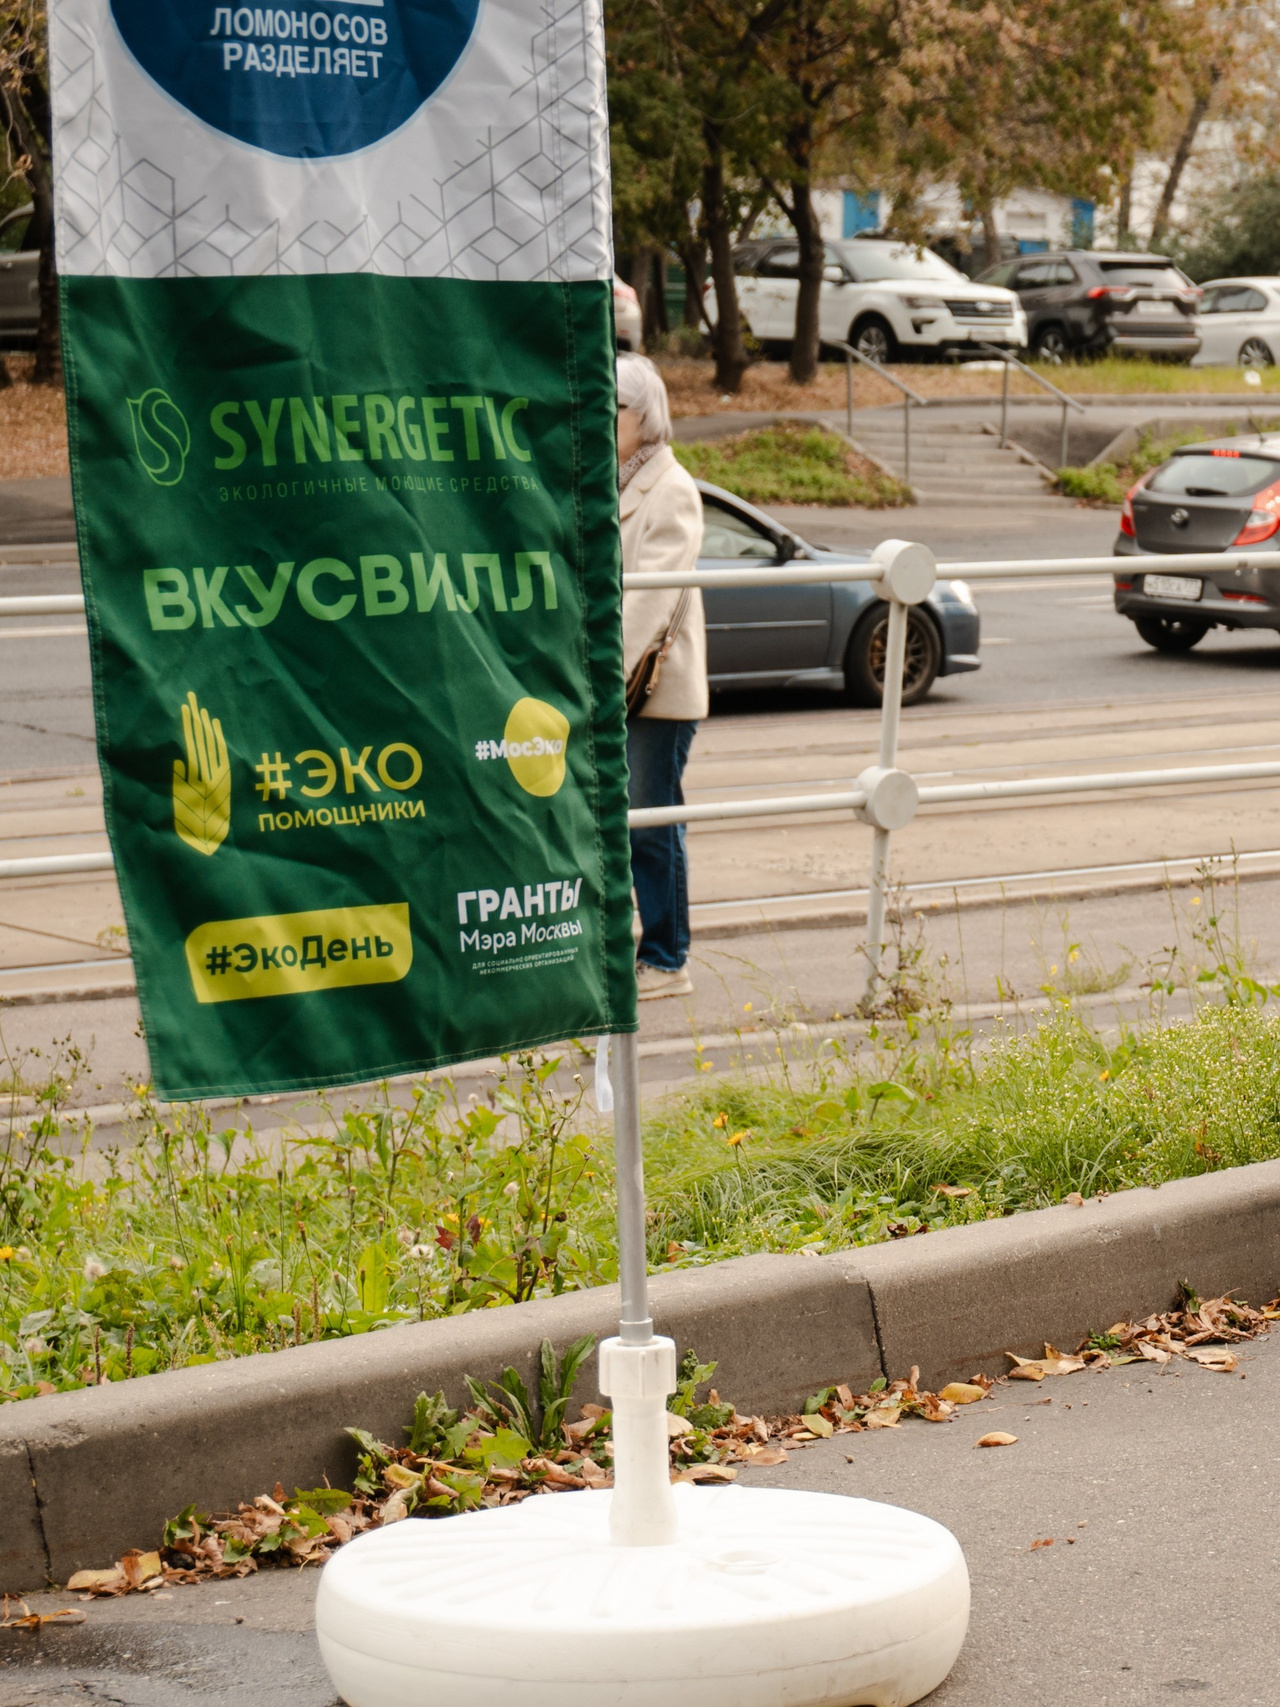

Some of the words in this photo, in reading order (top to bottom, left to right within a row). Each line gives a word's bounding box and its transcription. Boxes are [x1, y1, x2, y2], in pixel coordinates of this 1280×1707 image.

[210, 7, 388, 45] ЛОМОНОСОВ
[223, 42, 383, 78] РАЗДЕЛЯЕТ
[209, 393, 532, 470] SYNERGETIC
[219, 476, 368, 502] ЭКОЛОГИЧНЫЕ
[375, 475, 444, 493] МОЮЩИЕ
[450, 475, 540, 493] СРЕДСТВА
[143, 551, 558, 632] ВКУСВИЛЛ
[475, 736, 563, 760] #МосЭко
[255, 742, 423, 801] #ЭКО
[457, 877, 583, 925] ГРАНТЫ
[205, 934, 394, 976] #ЭкоДень
[460, 929, 516, 955] Мэра
[521, 919, 583, 945] Москвы
